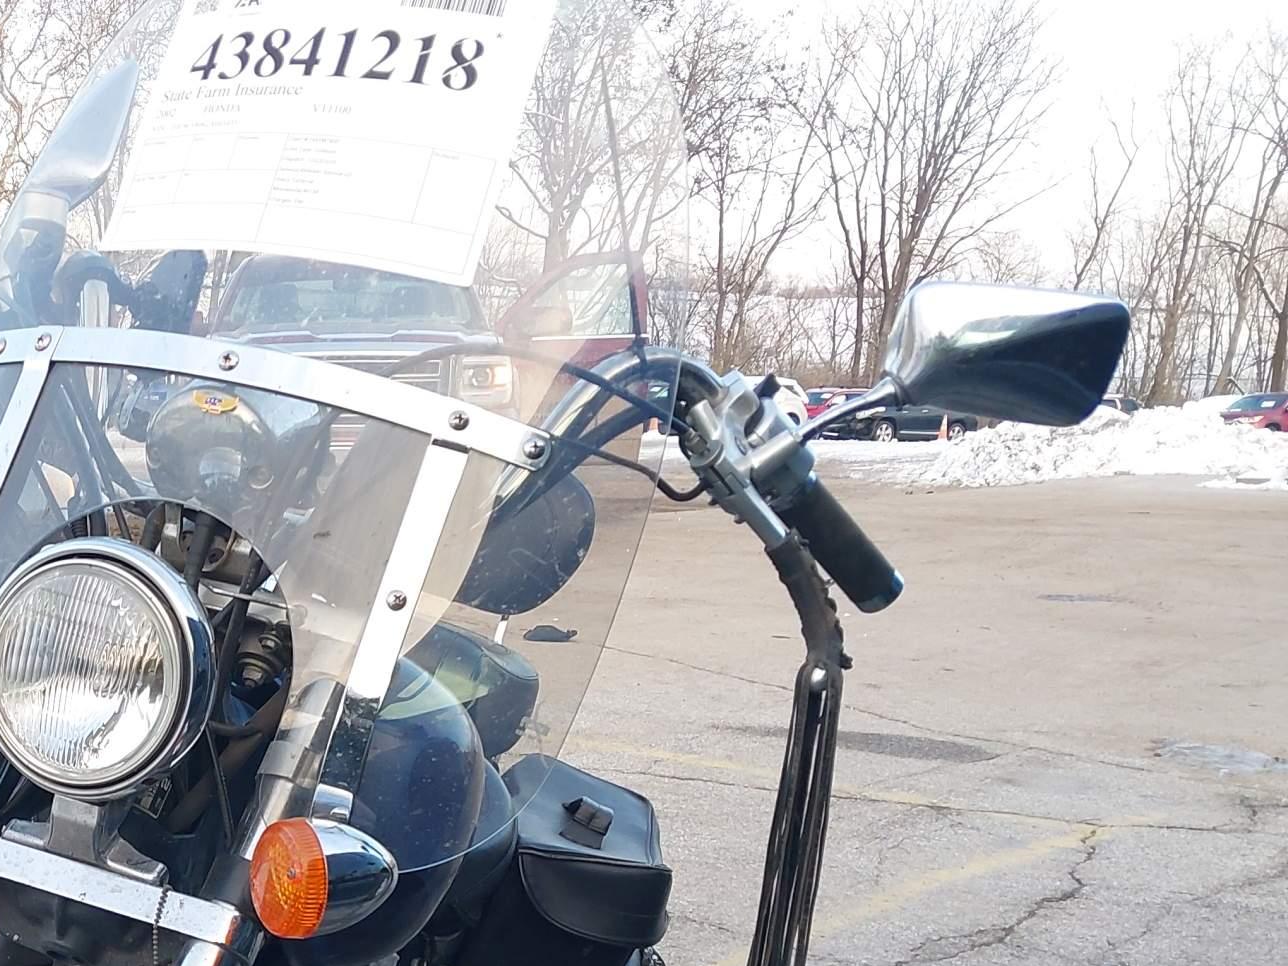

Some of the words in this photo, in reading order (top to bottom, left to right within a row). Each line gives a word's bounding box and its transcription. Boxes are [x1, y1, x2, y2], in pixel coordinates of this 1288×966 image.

[190, 26, 485, 91] 43841218
[162, 89, 193, 104] State
[196, 85, 231, 99] Farm
[234, 83, 304, 98] Insurance
[203, 103, 242, 114] HONDA
